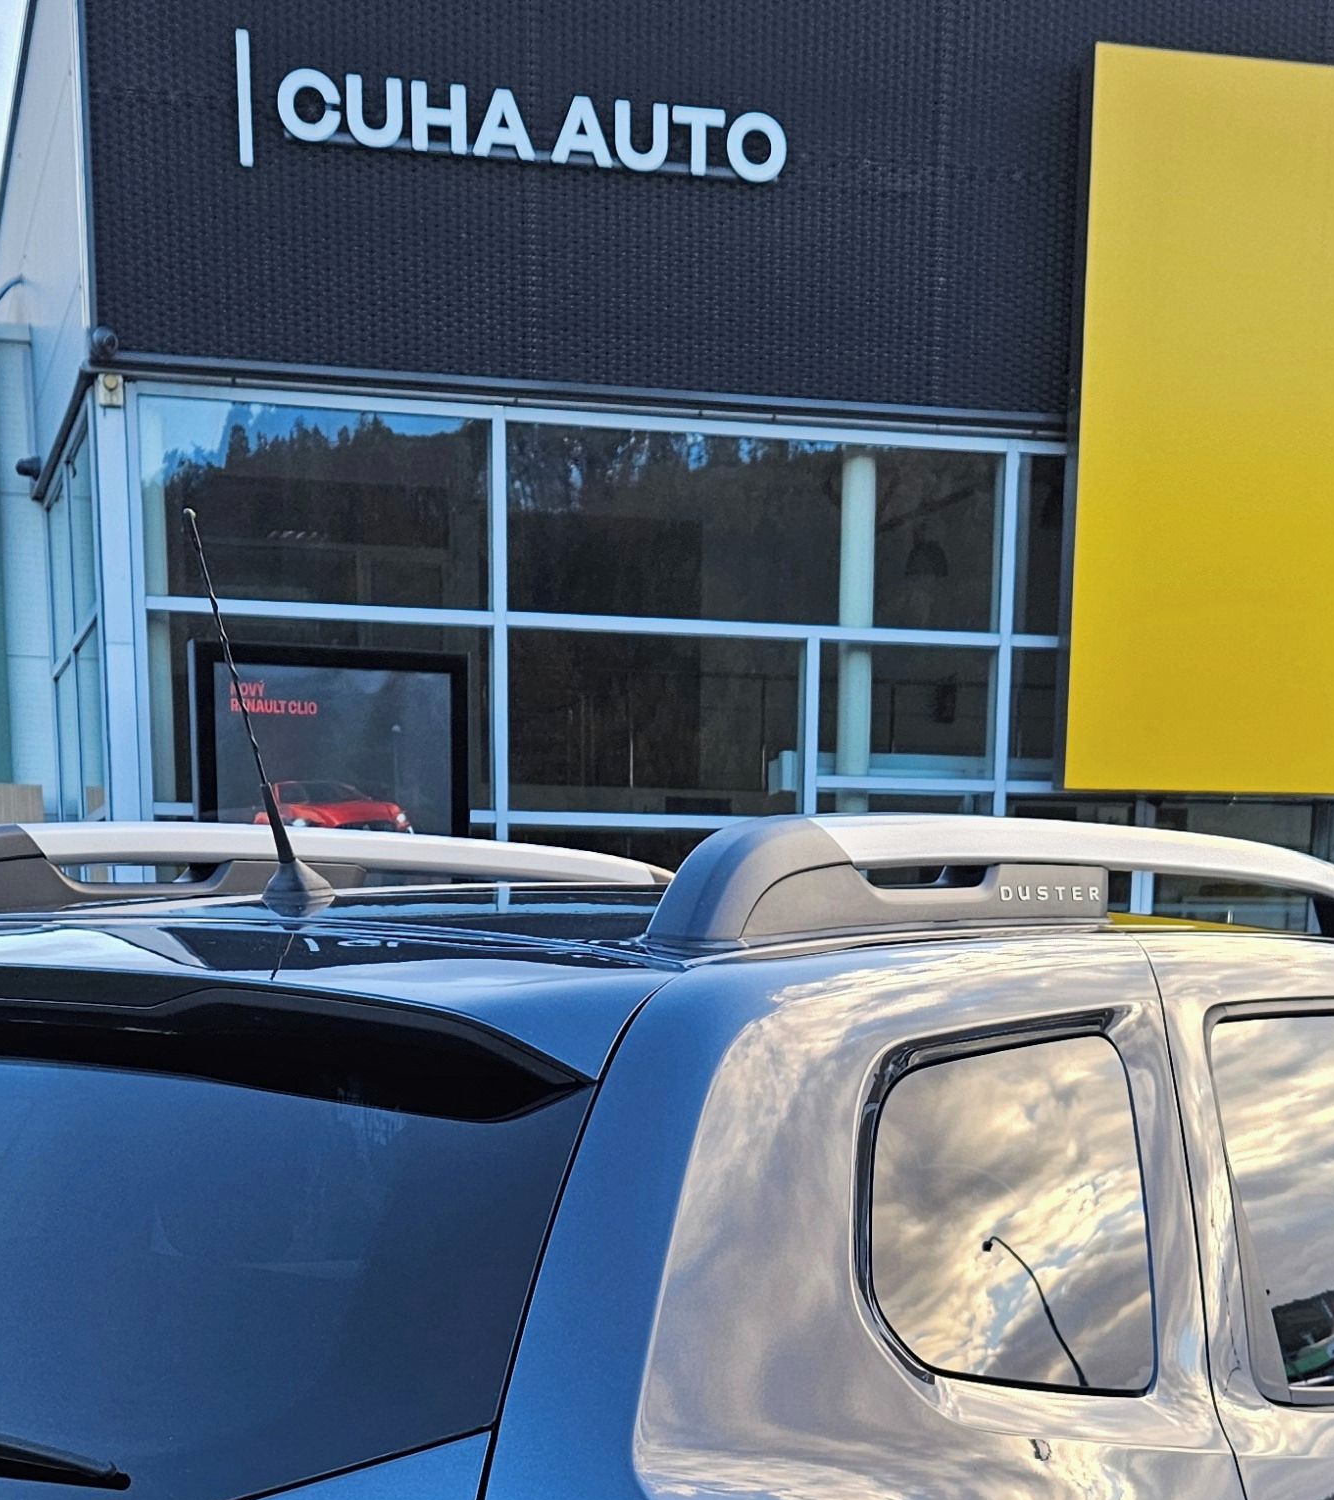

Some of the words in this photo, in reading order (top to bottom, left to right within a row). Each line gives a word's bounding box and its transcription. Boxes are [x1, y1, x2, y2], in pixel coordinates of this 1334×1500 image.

[277, 68, 535, 161] CUHA
[550, 95, 787, 183] AUTO
[230, 698, 286, 714] RNAULT
[288, 700, 317, 714] CLIO
[1000, 884, 1101, 902] DUSTER
